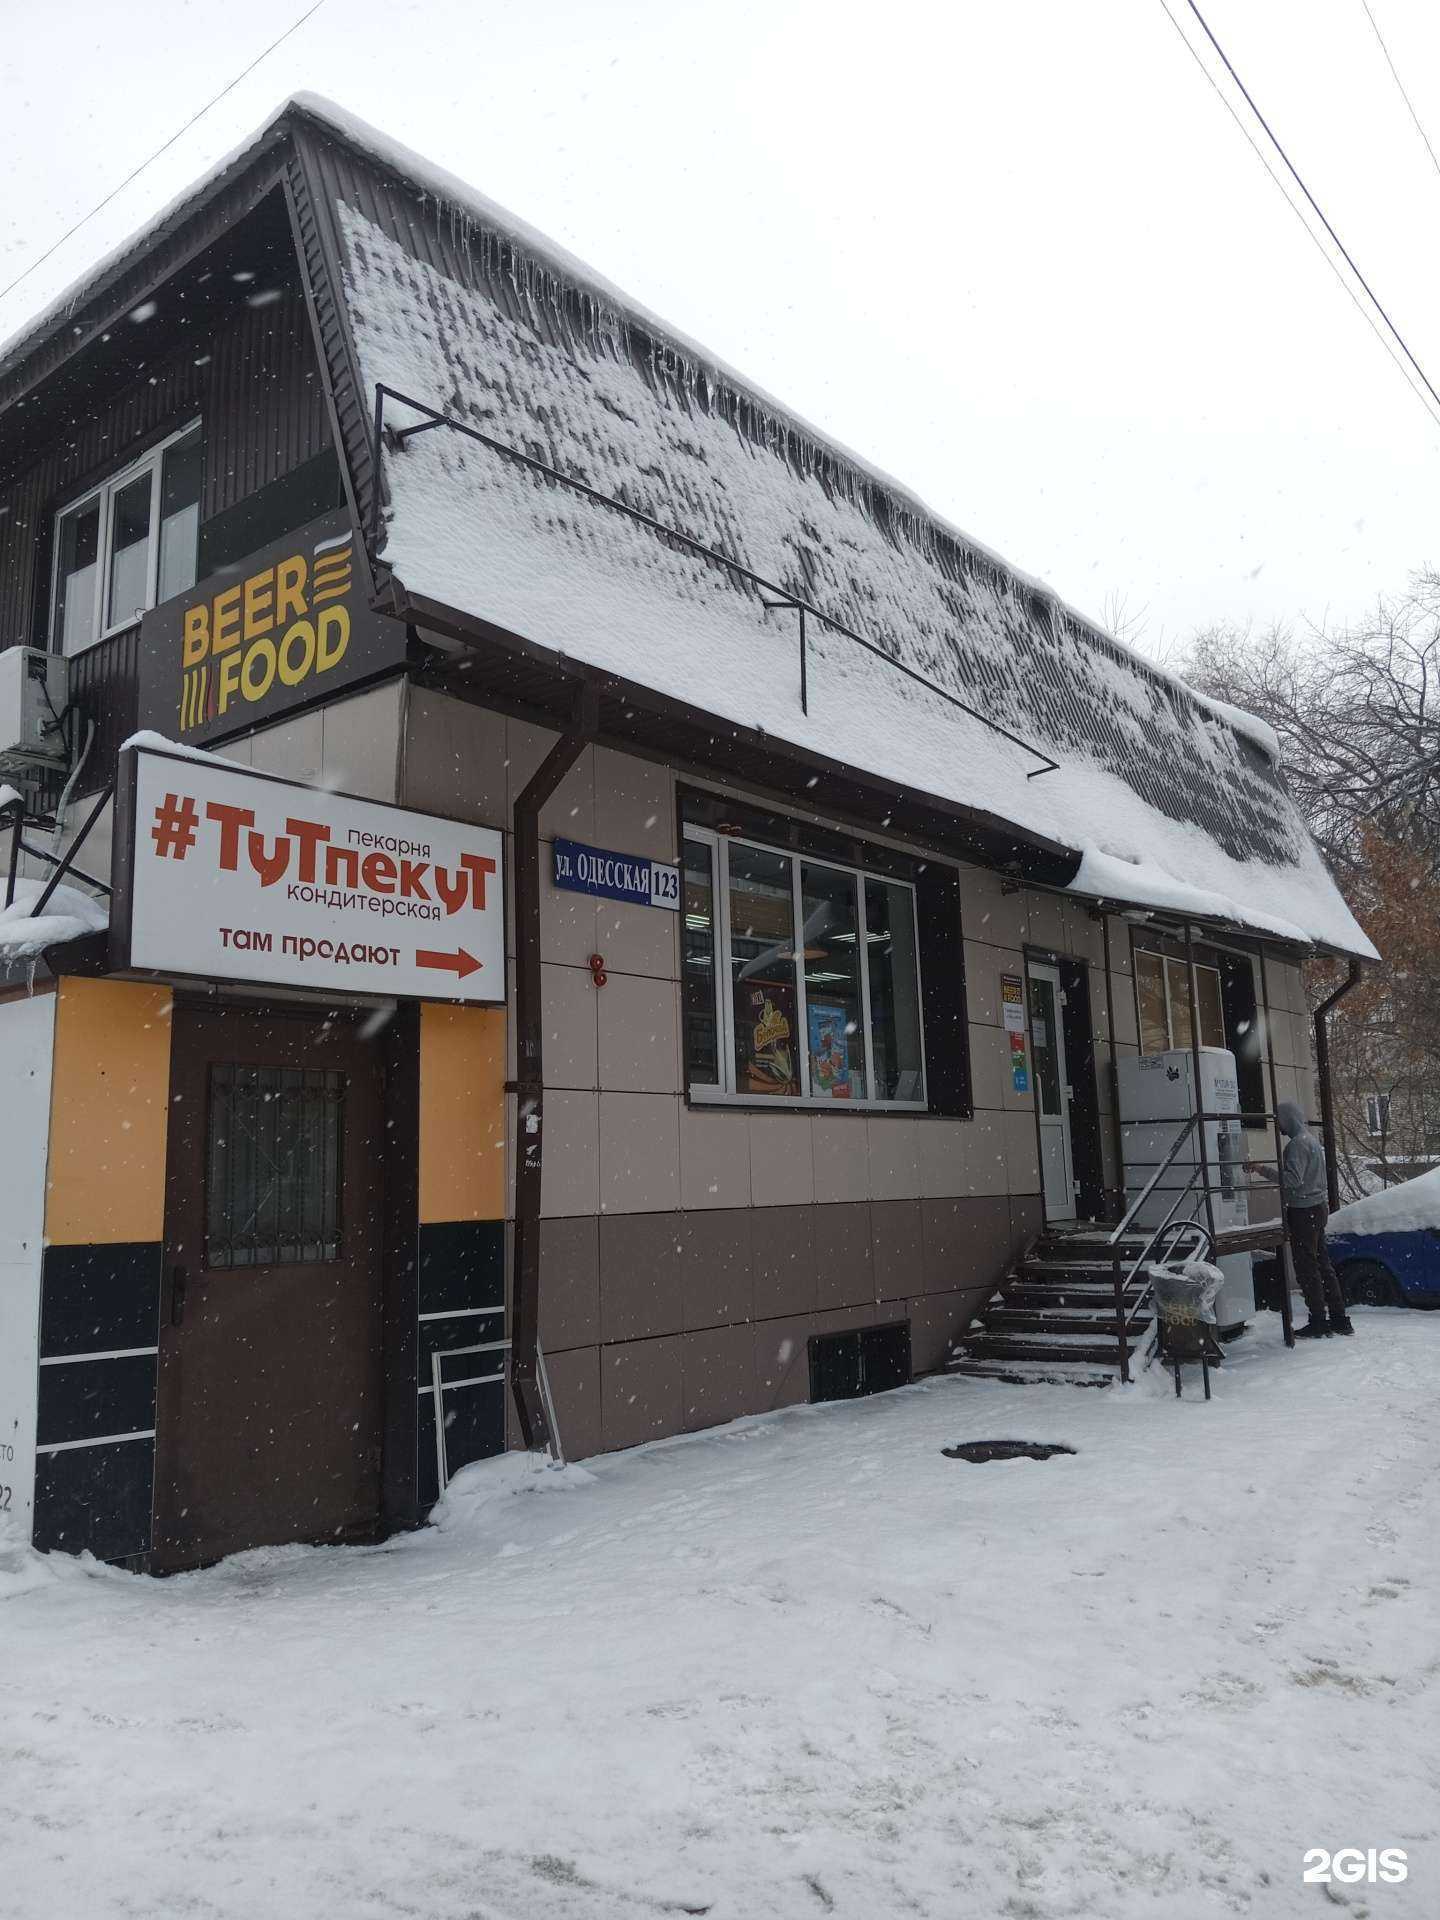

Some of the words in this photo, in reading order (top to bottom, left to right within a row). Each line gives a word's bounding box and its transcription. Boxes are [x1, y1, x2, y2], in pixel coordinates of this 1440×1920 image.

[182, 555, 308, 669] BEER
[217, 604, 350, 715] FOOD
[347, 829, 430, 857] пекарня
[556, 854, 573, 880] ул.
[577, 853, 650, 894] ОДЕССКАЯ
[653, 871, 678, 900] 123
[287, 884, 441, 921] кондитерская
[219, 926, 272, 952] там
[282, 934, 400, 966] продают
[0, 1444, 13, 1461] ТО
